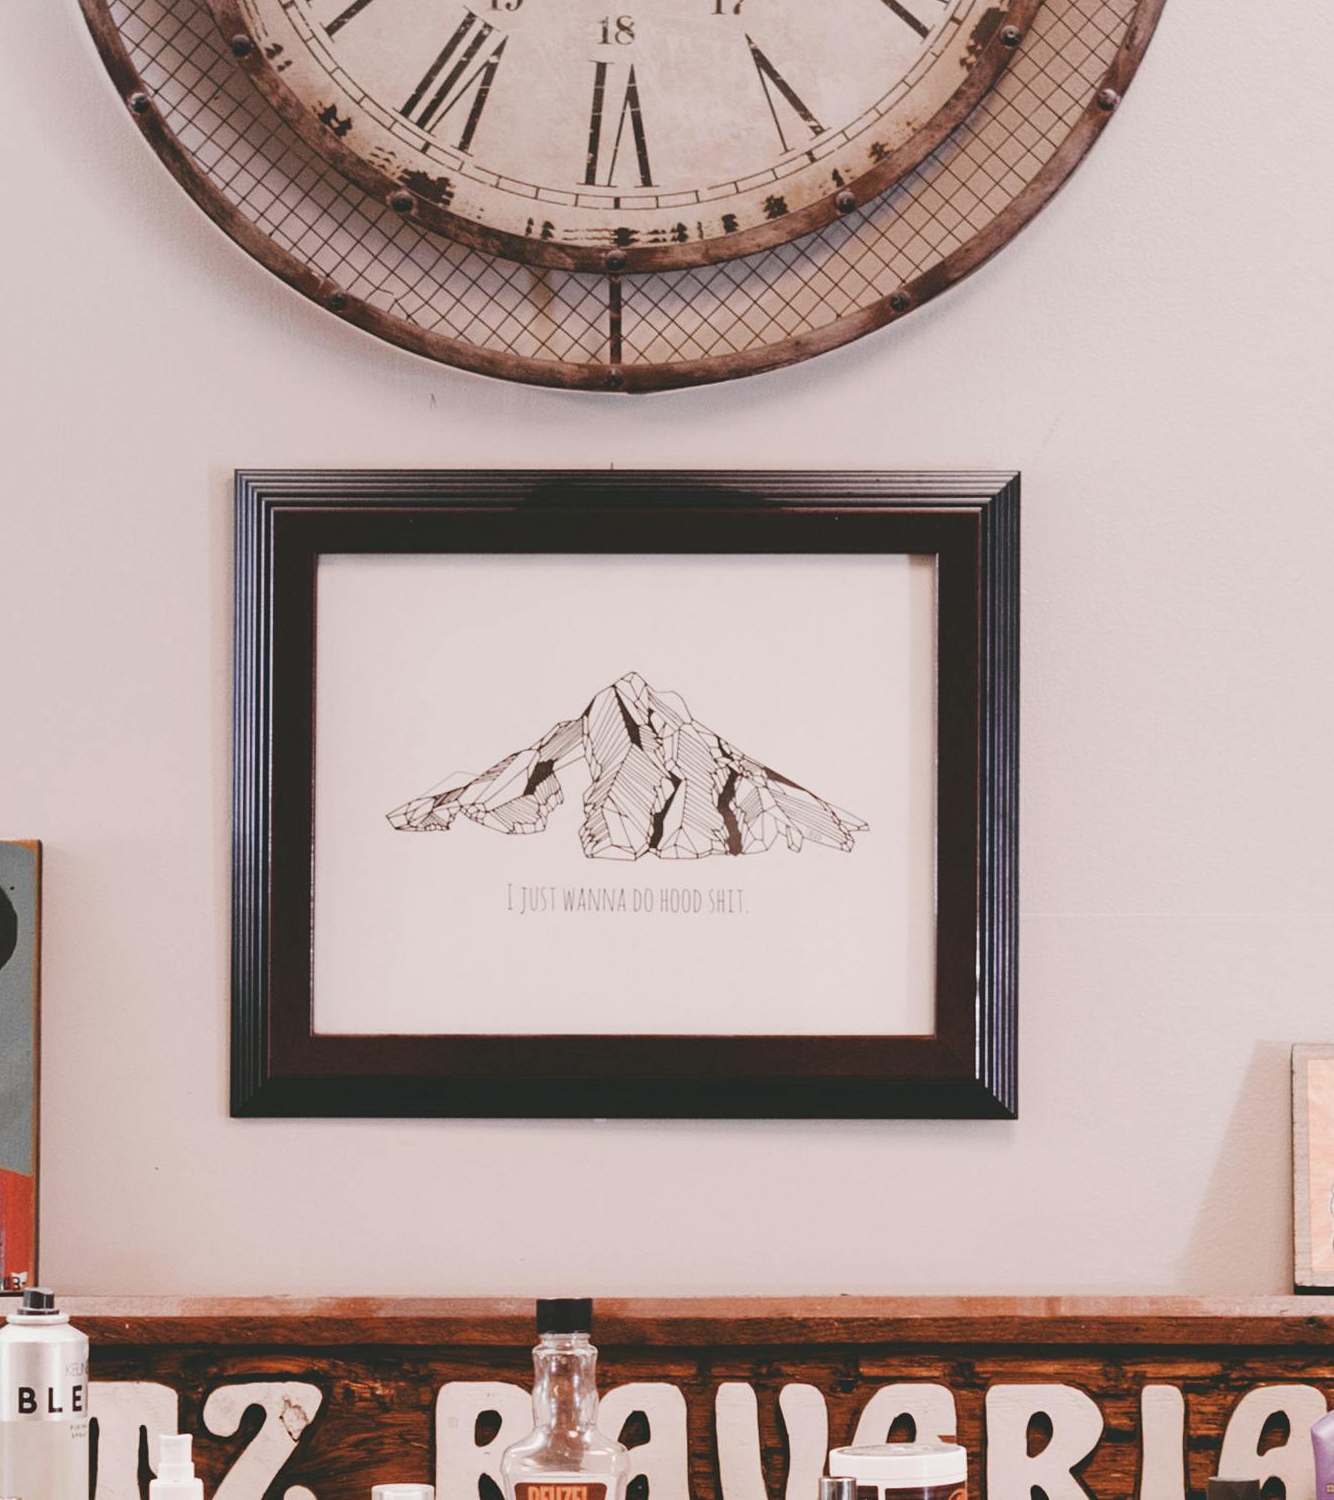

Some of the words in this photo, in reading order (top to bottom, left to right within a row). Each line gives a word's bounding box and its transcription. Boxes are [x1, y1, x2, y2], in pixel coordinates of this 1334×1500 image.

[597, 16, 637, 47] 18
[507, 883, 514, 911] I
[519, 886, 556, 915] JUST
[562, 887, 627, 912] WANNA
[632, 888, 654, 913] DO
[659, 888, 703, 914] HOOD
